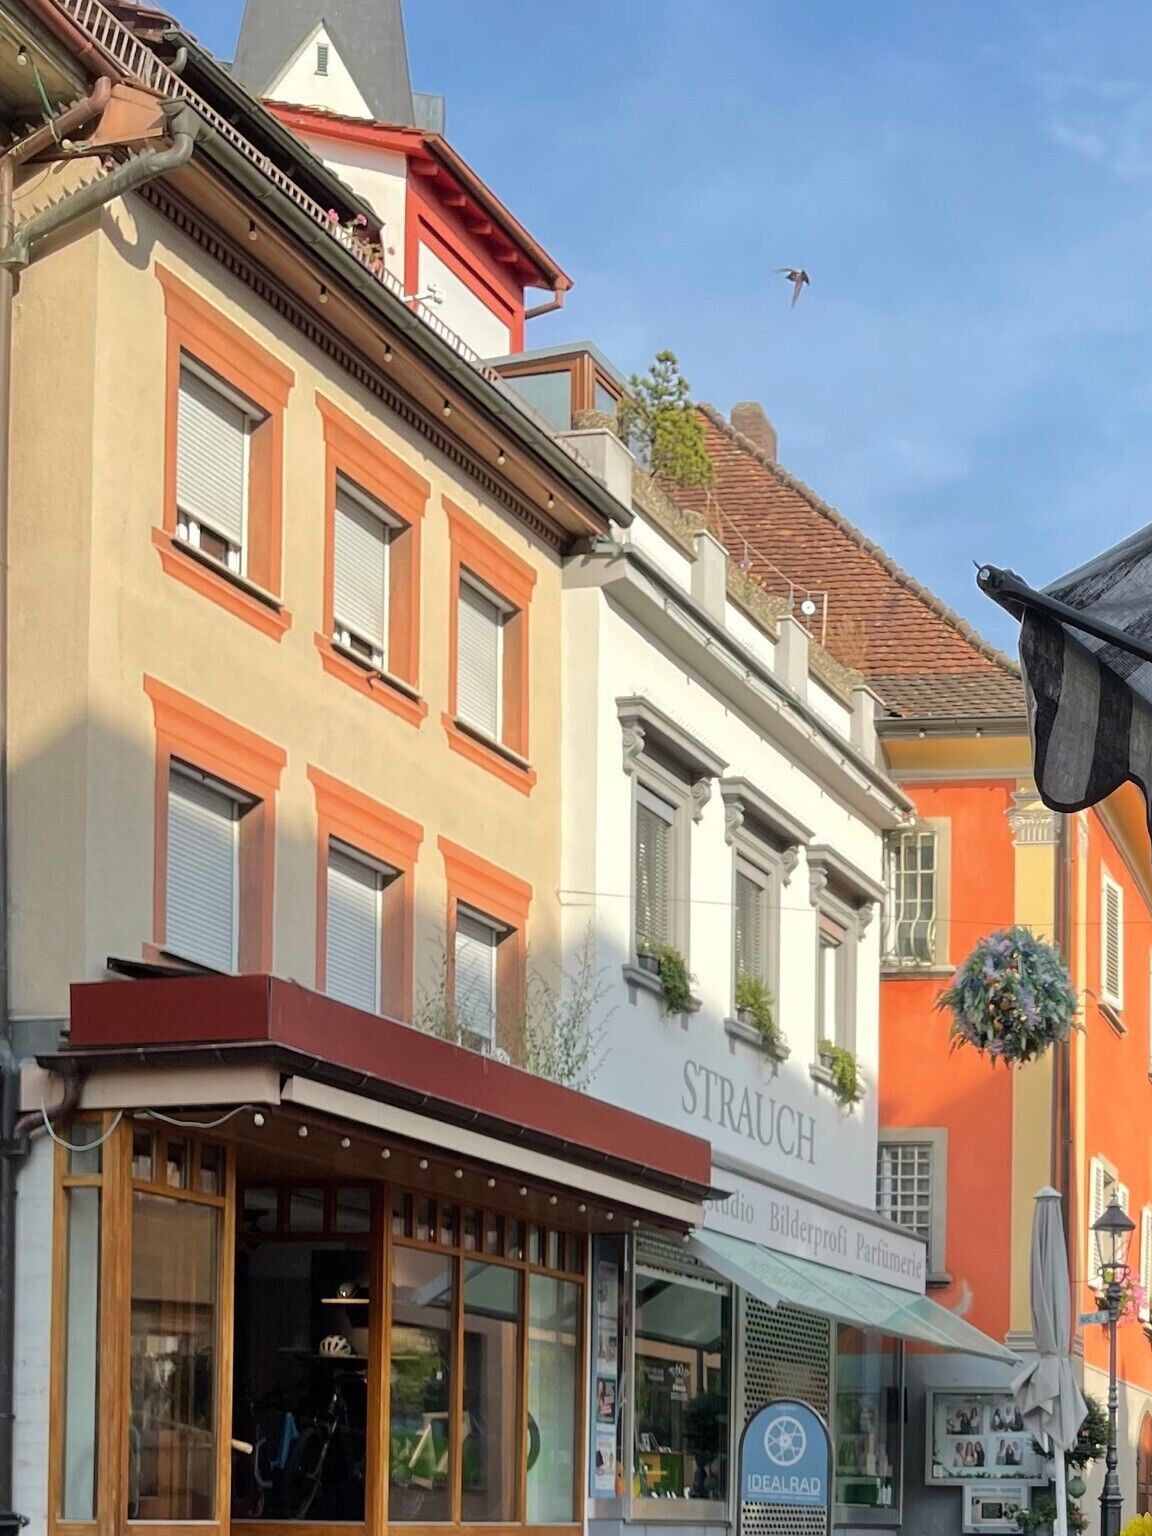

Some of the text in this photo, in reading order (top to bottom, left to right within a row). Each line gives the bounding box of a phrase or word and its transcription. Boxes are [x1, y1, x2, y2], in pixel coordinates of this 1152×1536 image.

[682, 1060, 816, 1165] STRAUCH
[769, 1201, 848, 1256] Bilderprofi
[856, 1231, 922, 1279] Parfümerie
[748, 1474, 821, 1494] IDEALRAD
